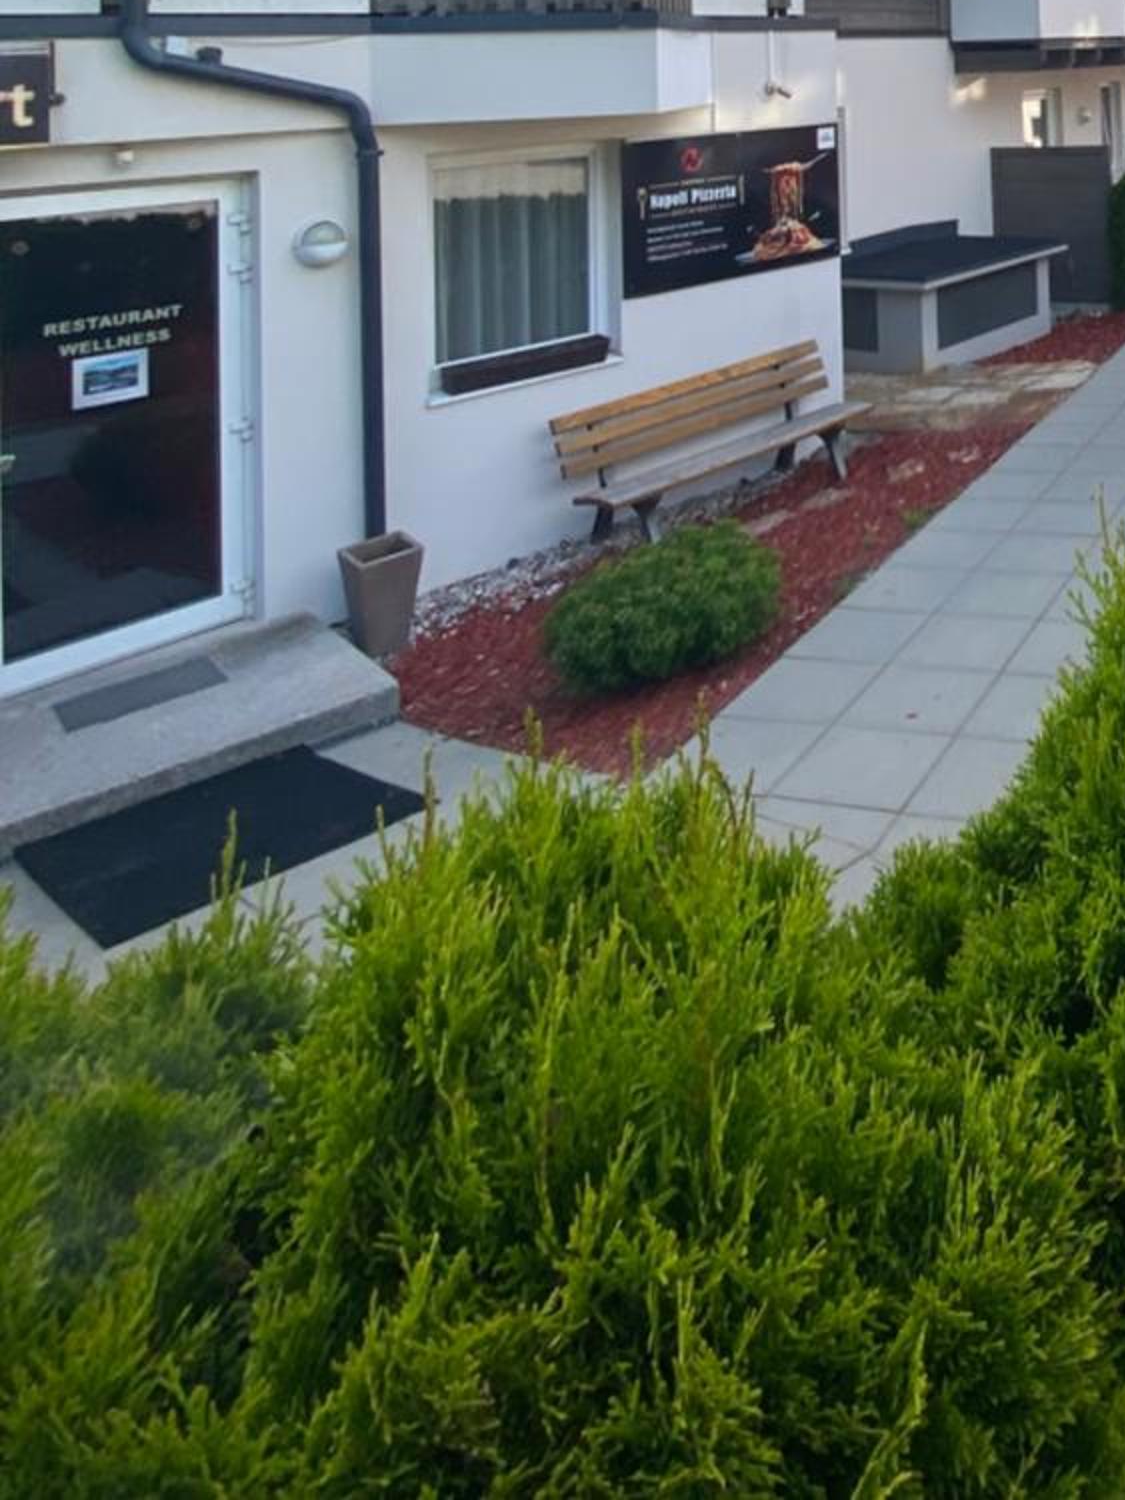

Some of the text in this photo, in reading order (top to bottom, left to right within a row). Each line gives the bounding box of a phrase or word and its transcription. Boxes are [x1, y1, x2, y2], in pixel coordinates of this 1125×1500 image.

[690, 184, 736, 204] Pizzeria
[43, 304, 183, 338] RESTAURANT
[58, 328, 172, 357] WELLNESS
